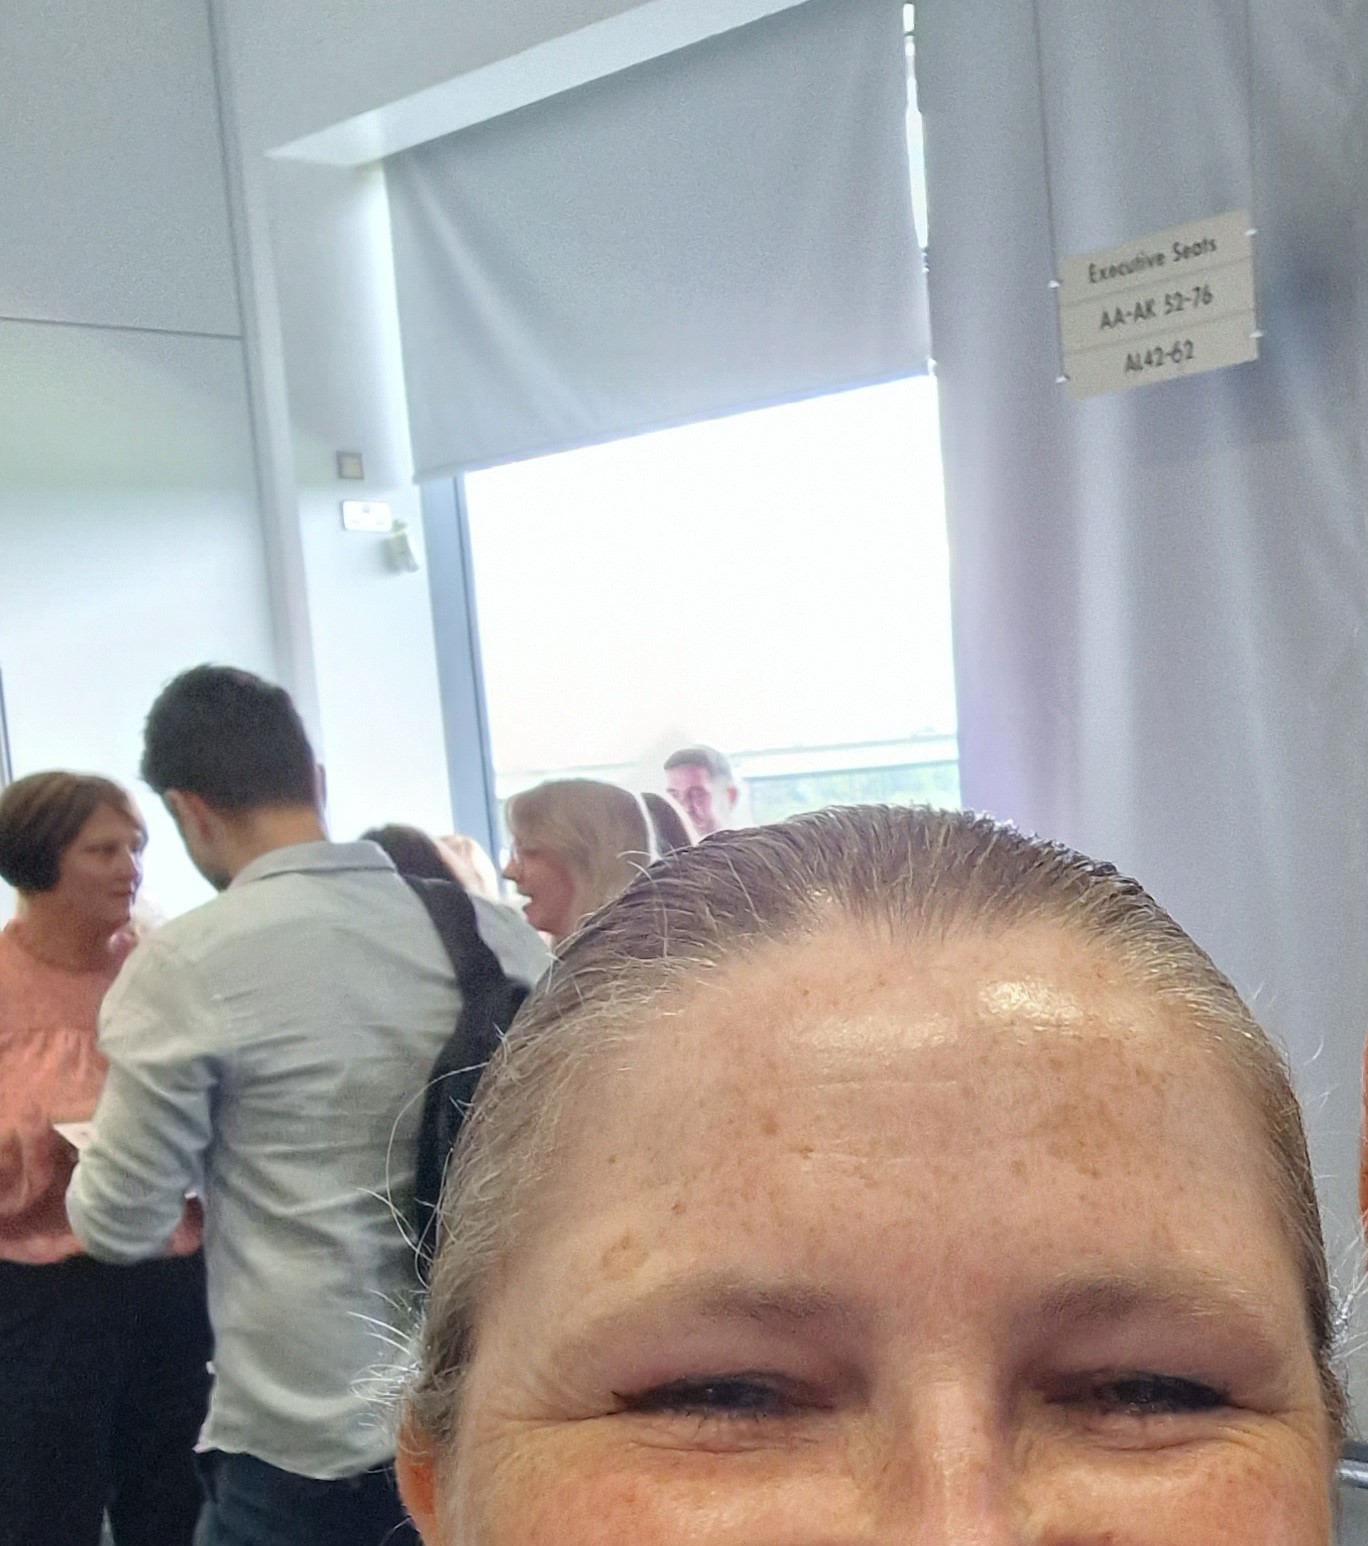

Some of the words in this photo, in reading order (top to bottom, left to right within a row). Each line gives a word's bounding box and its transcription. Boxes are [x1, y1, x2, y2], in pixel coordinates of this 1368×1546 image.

[1088, 252, 1165, 284] Executive
[1172, 238, 1217, 262] Seats
[1100, 298, 1156, 330] AA-AK
[1164, 284, 1213, 315] 52-76
